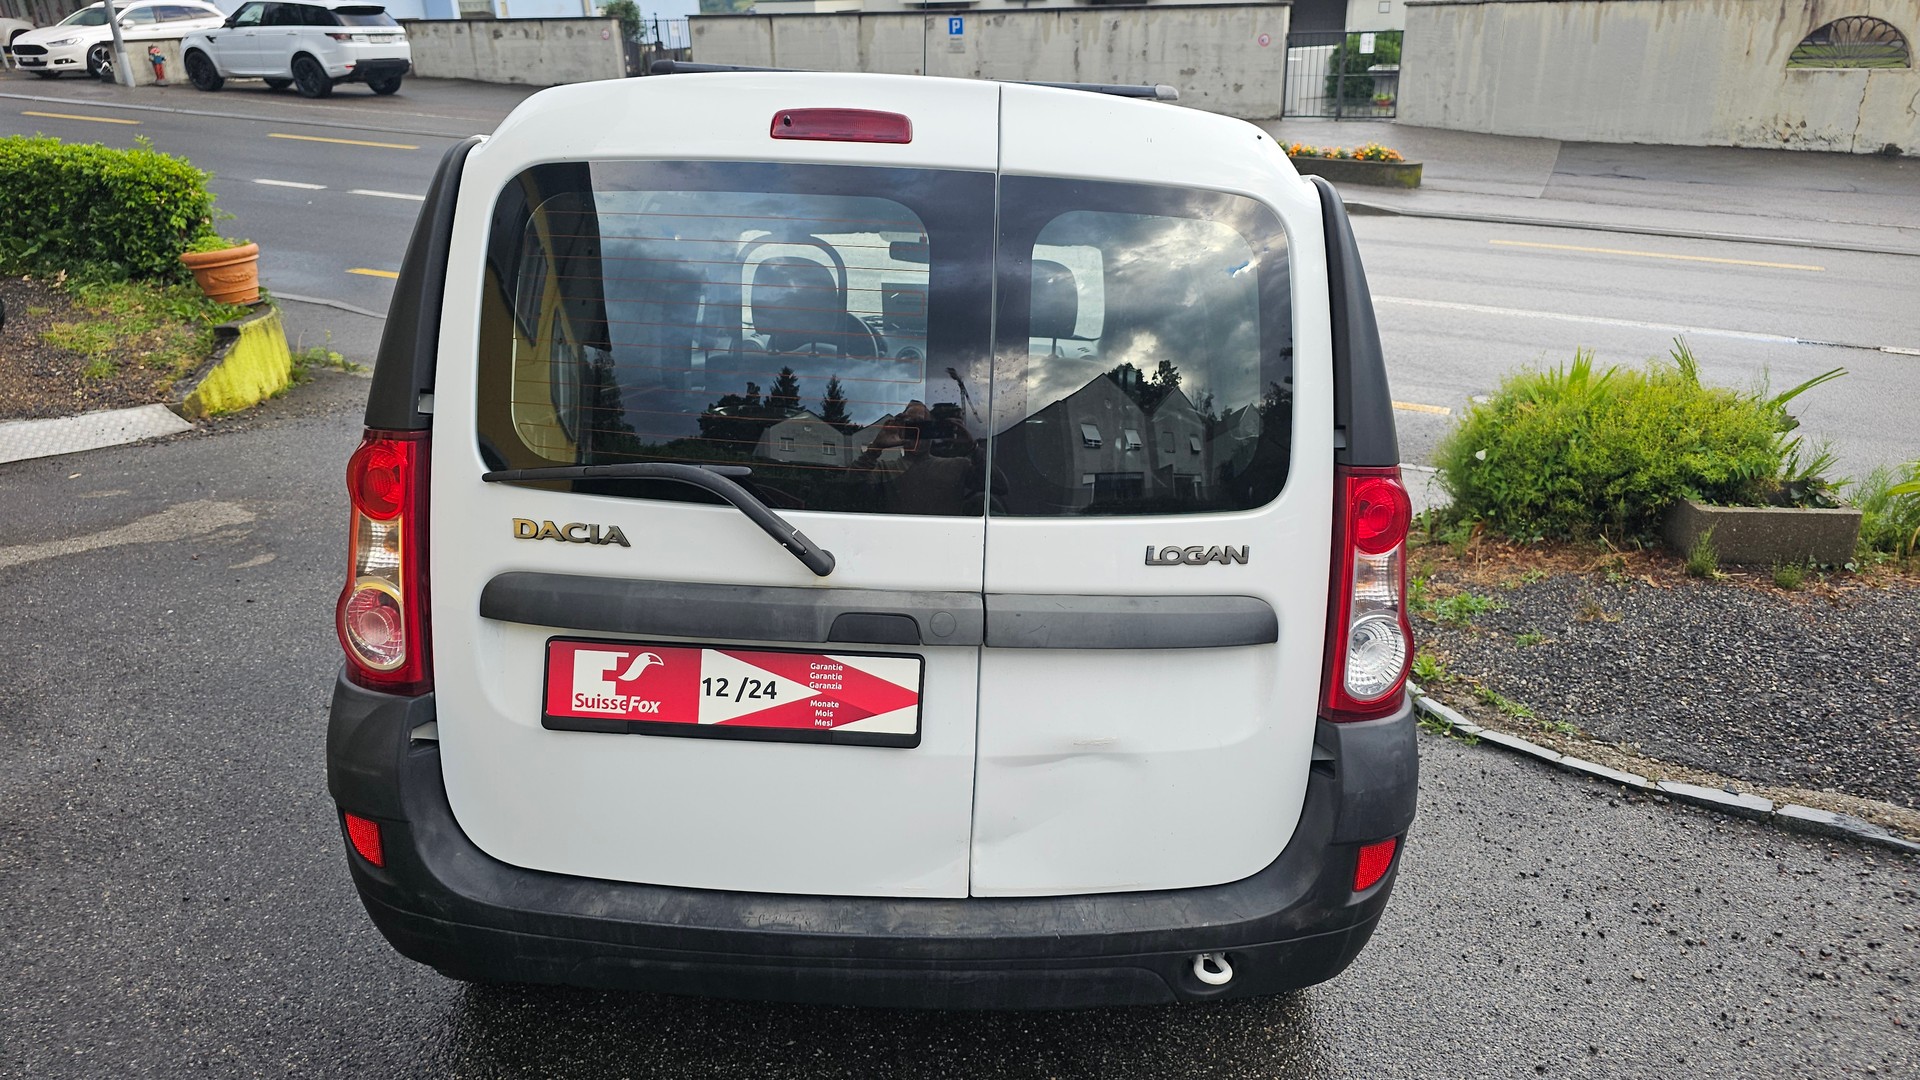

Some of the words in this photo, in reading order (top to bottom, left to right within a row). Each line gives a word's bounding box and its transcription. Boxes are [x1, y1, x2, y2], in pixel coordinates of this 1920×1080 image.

[952, 19, 960, 33] P
[512, 517, 631, 547] DACIA
[1145, 545, 1250, 566] LOGAN
[810, 662, 843, 671] Garantie
[809, 672, 843, 681] Garantie
[702, 677, 729, 697] 12
[734, 677, 777, 702] /24
[809, 681, 843, 690] Garanzia
[810, 699, 840, 708] Monate
[815, 709, 834, 717] Mois
[814, 719, 833, 727] Mesi
